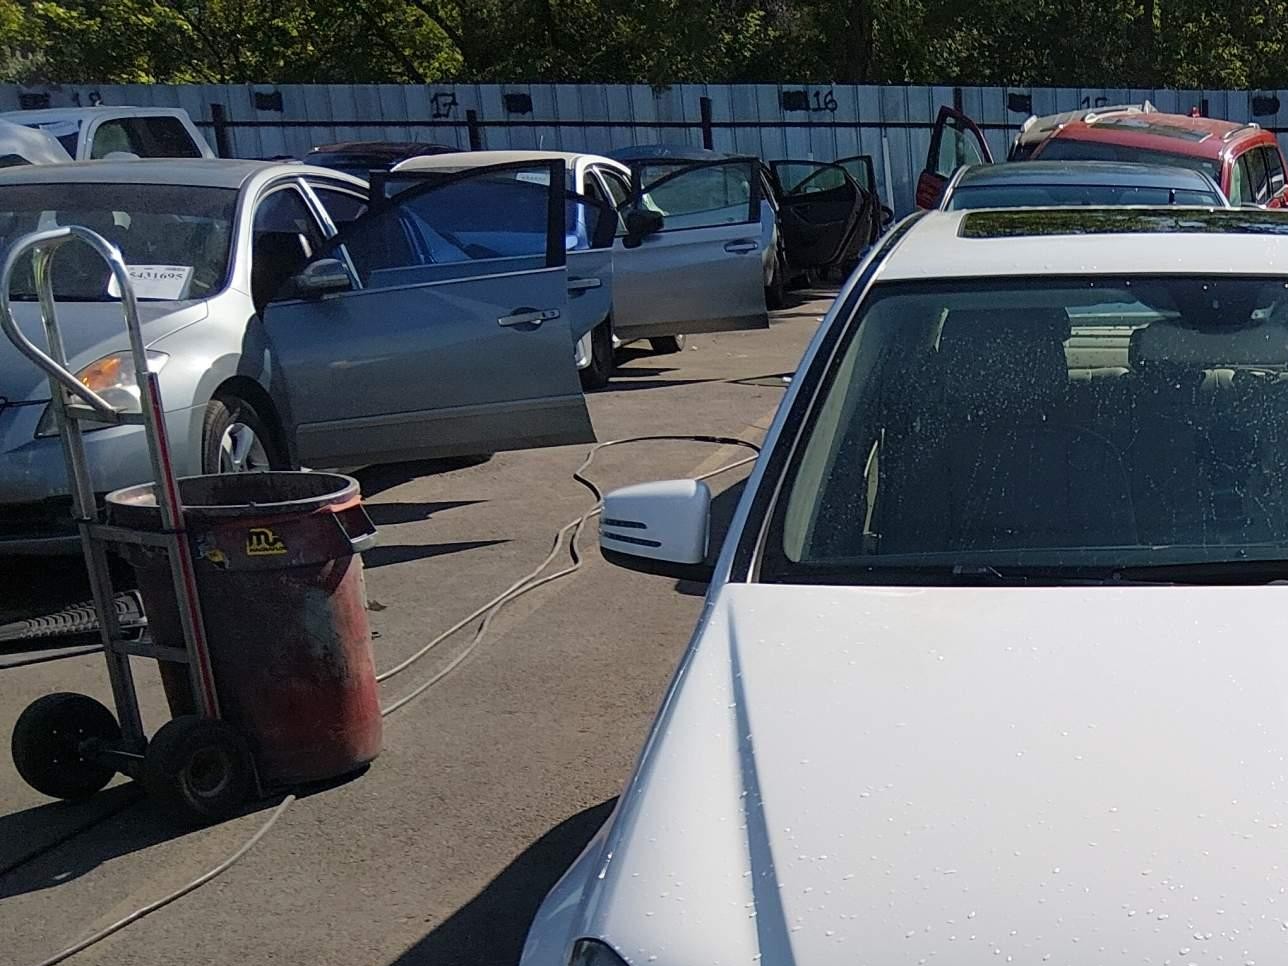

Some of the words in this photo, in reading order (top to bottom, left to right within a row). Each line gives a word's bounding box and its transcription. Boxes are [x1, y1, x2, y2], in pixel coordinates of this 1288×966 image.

[431, 92, 458, 118] 17
[811, 90, 838, 112] 16
[128, 271, 184, 280] 5431695
